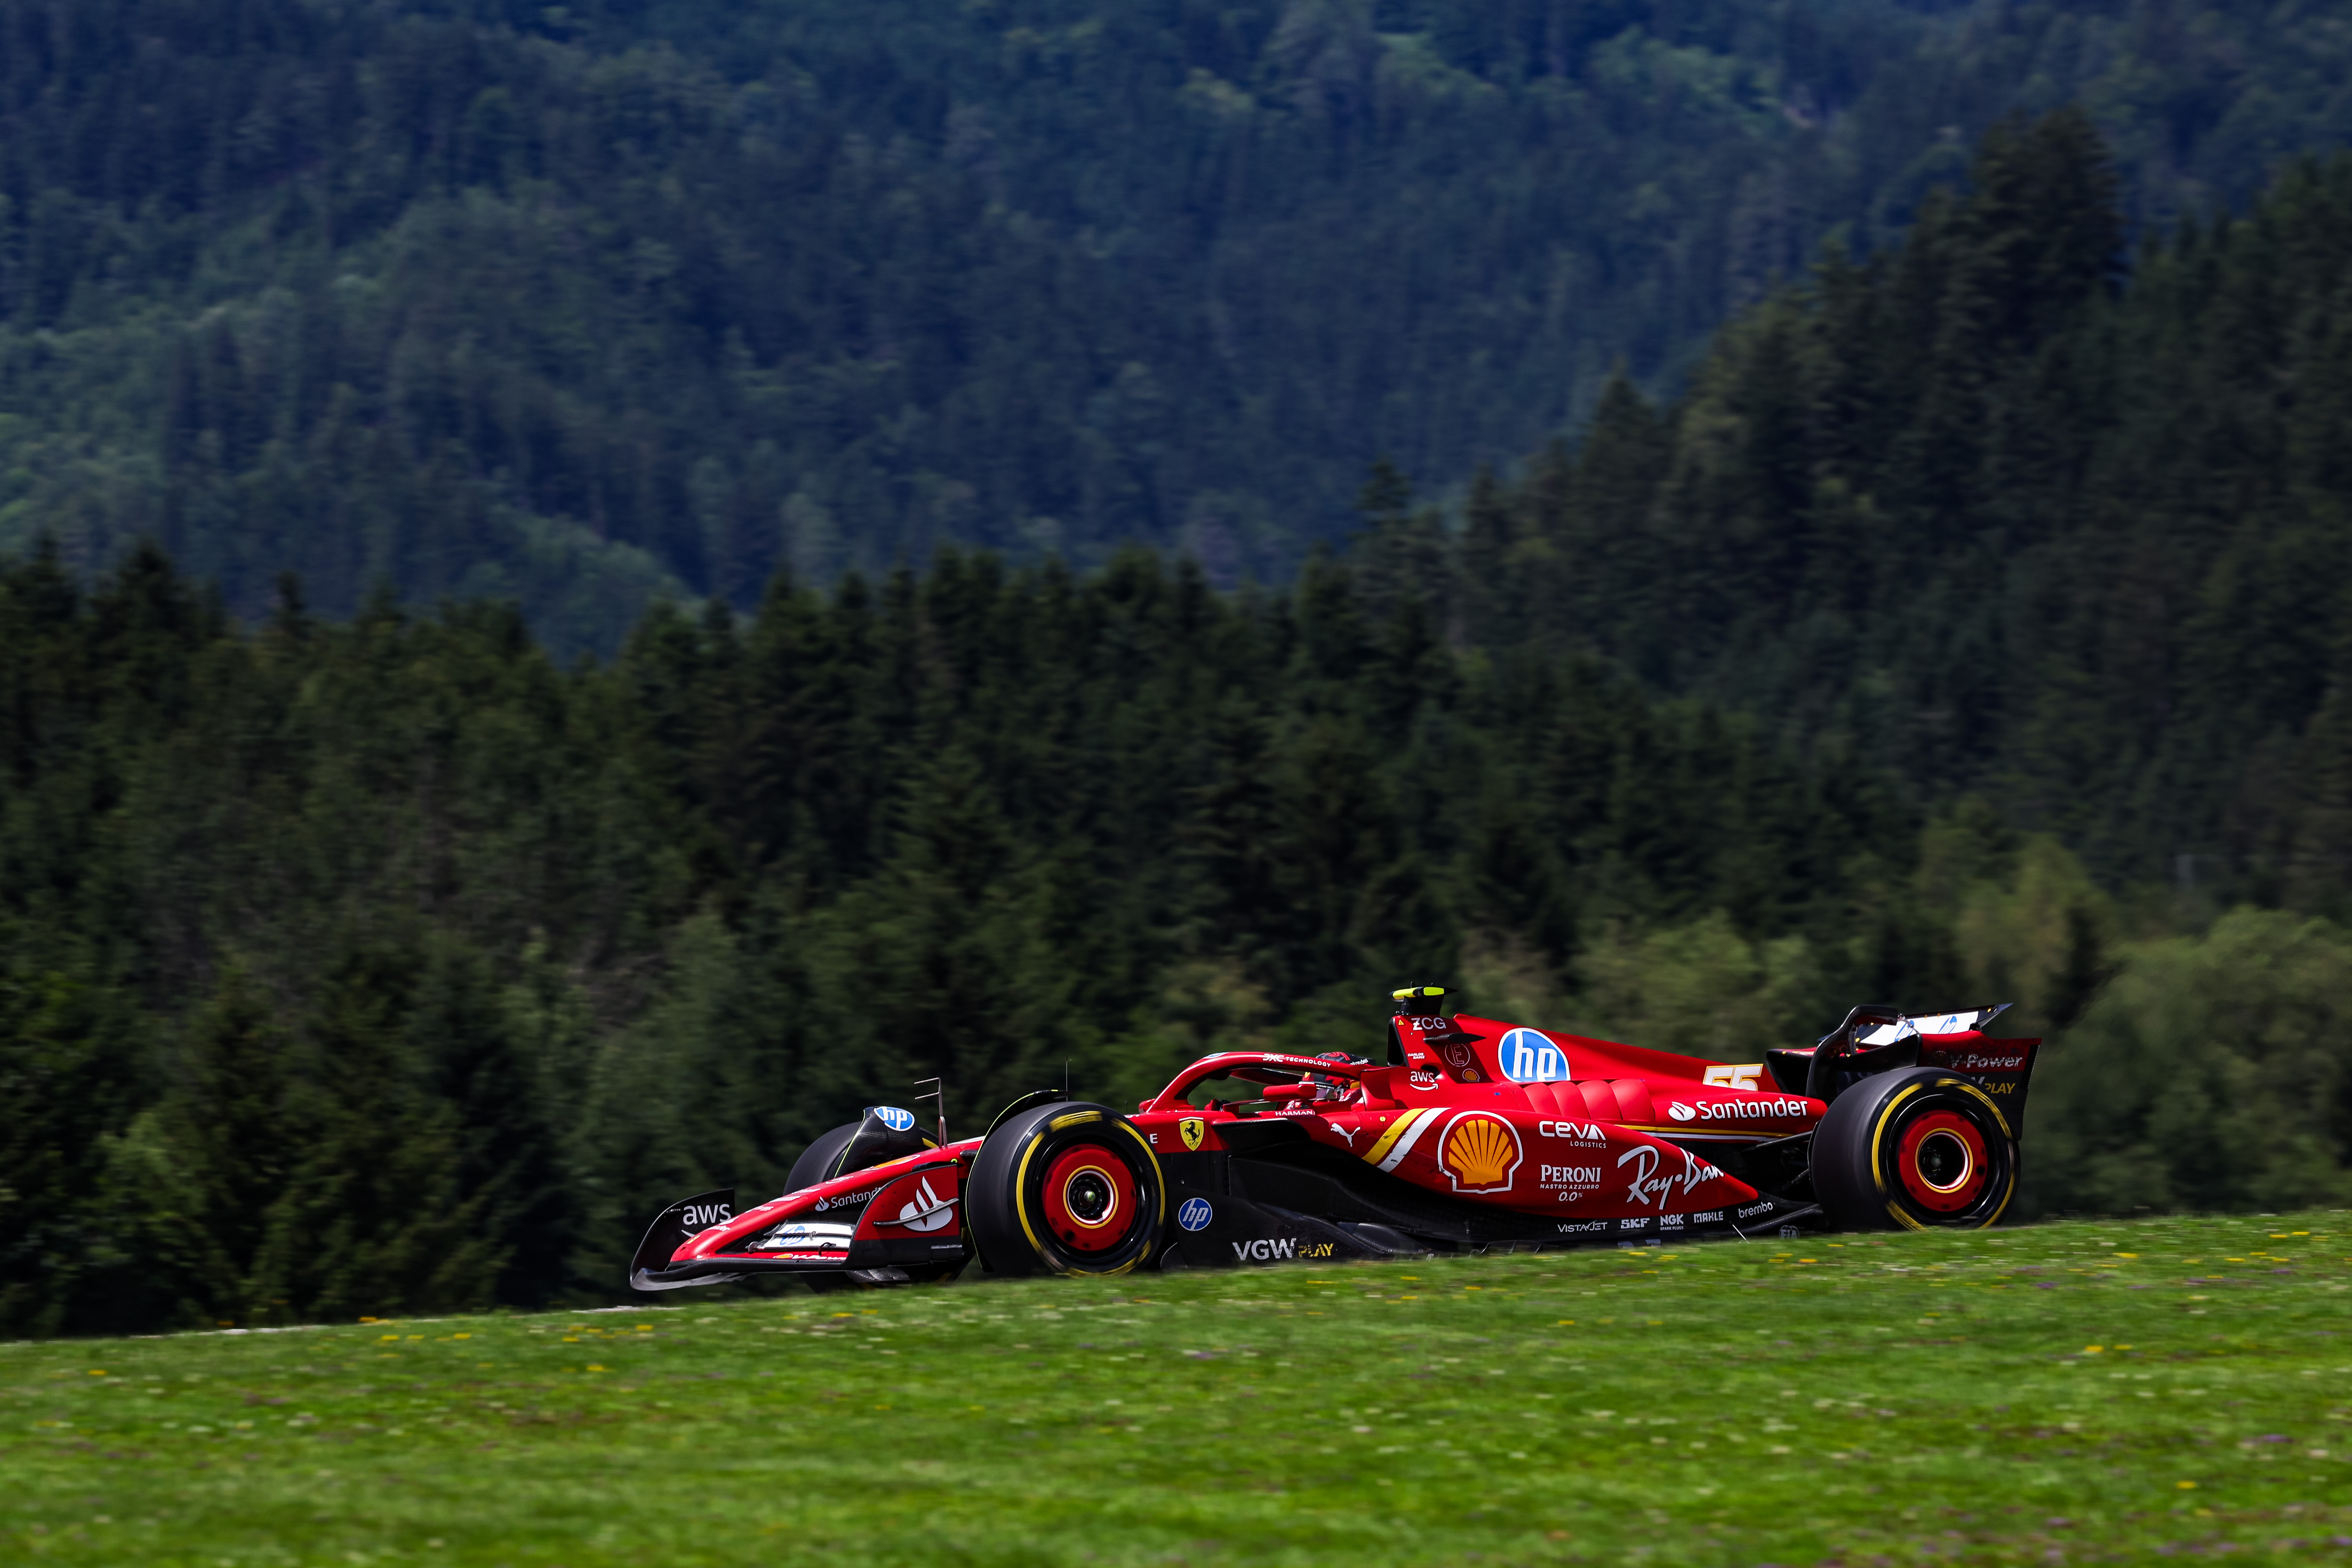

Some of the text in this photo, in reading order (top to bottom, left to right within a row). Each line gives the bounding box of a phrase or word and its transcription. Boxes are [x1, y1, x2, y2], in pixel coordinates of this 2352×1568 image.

[1411, 1017, 1446, 1031] ZCG
[1262, 1053, 1284, 1062] DXC
[1286, 1056, 1331, 1067] TECHNOLOGY
[1950, 1054, 2023, 1069] V-Power
[1410, 1071, 1435, 1083] aws
[1696, 1097, 1808, 1120] Santander
[1541, 1164, 1601, 1182] PERONI
[831, 1187, 882, 1208] Santand
[1559, 1192, 1583, 1202] 0.0%
[683, 1204, 731, 1225] aws
[1694, 1211, 1723, 1223] MAHLE
[1738, 1202, 1773, 1218] brembo
[1621, 1218, 1650, 1229] SKF
[1660, 1214, 1684, 1226] NGK
[1232, 1238, 1334, 1261] VGW PLAY
